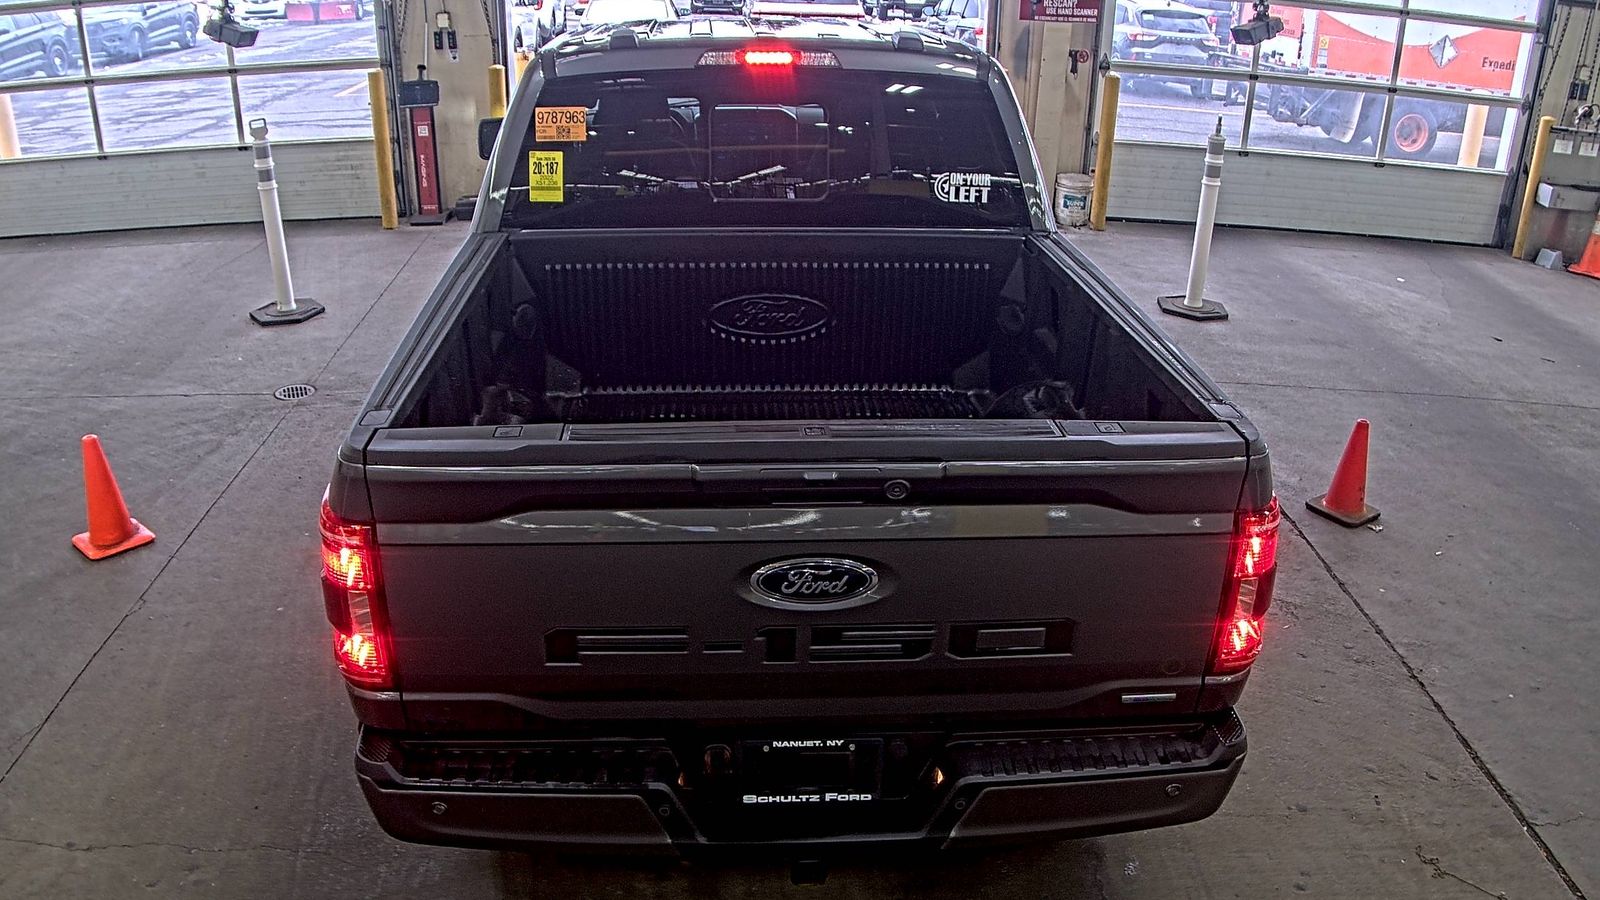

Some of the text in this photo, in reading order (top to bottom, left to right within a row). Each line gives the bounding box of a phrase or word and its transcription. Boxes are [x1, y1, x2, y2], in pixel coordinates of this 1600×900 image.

[1073, 8, 1098, 16] SCANNER
[537, 110, 585, 124] 9787963
[533, 161, 559, 174] 20:187
[950, 172, 991, 186] ON YOUR
[949, 186, 991, 203] LEFT
[781, 568, 848, 596] Ford
[543, 617, 1077, 667] F-150
[826, 739, 845, 747] NY
